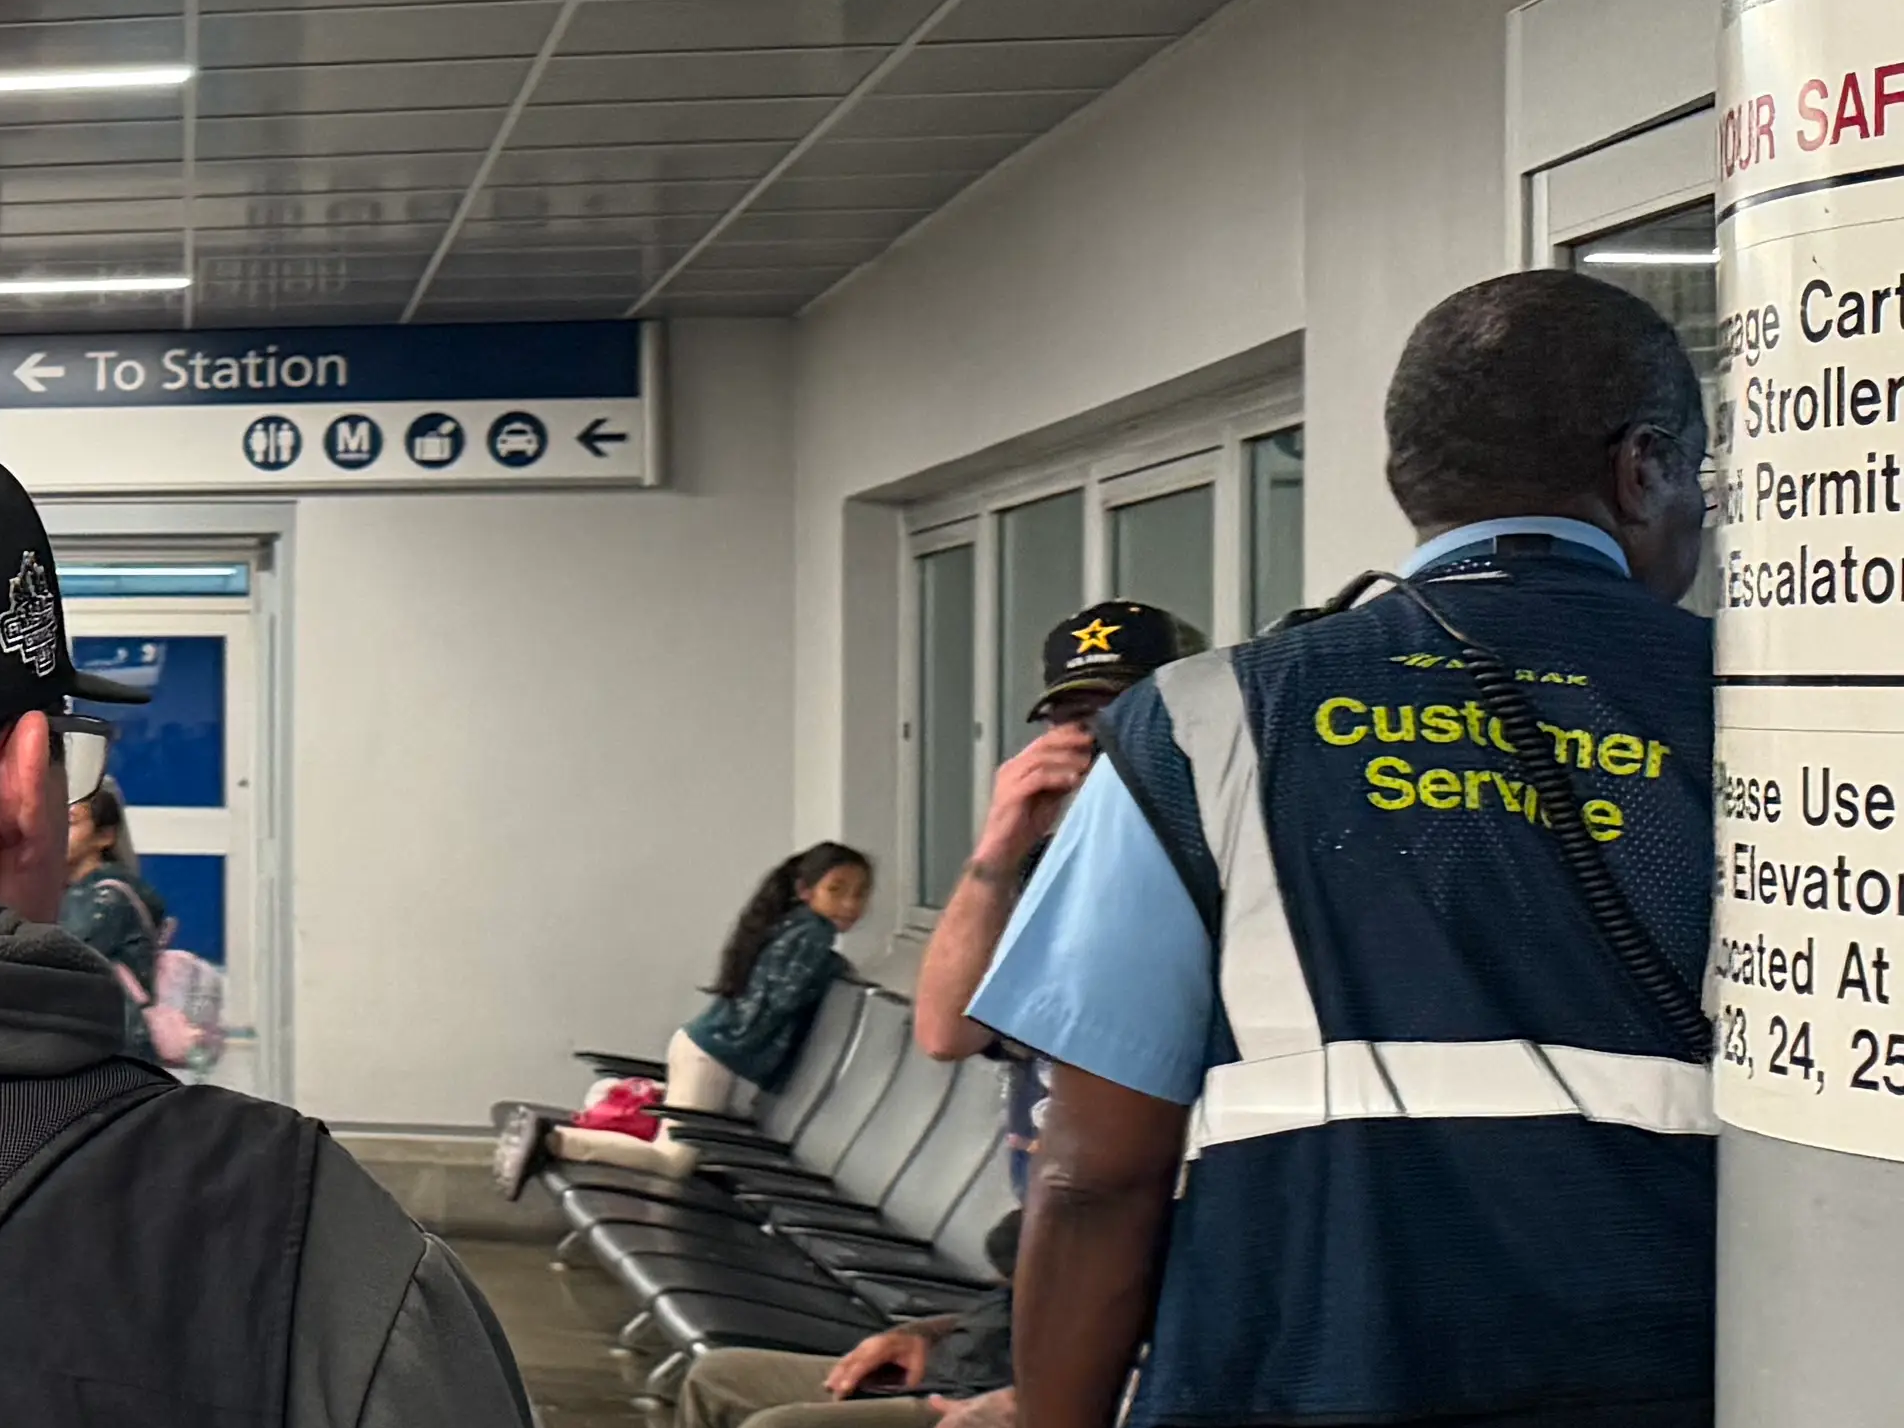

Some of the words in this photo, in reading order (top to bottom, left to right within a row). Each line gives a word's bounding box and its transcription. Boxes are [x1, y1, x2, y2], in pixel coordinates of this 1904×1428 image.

[85, 351, 146, 392] To
[162, 345, 349, 391] Station
[1756, 452, 1901, 521] Permit
[1365, 756, 1624, 842] Servie
[1802, 766, 1895, 830] Use
[1837, 941, 1890, 1004] At
[1769, 1015, 1824, 1095] 24,
